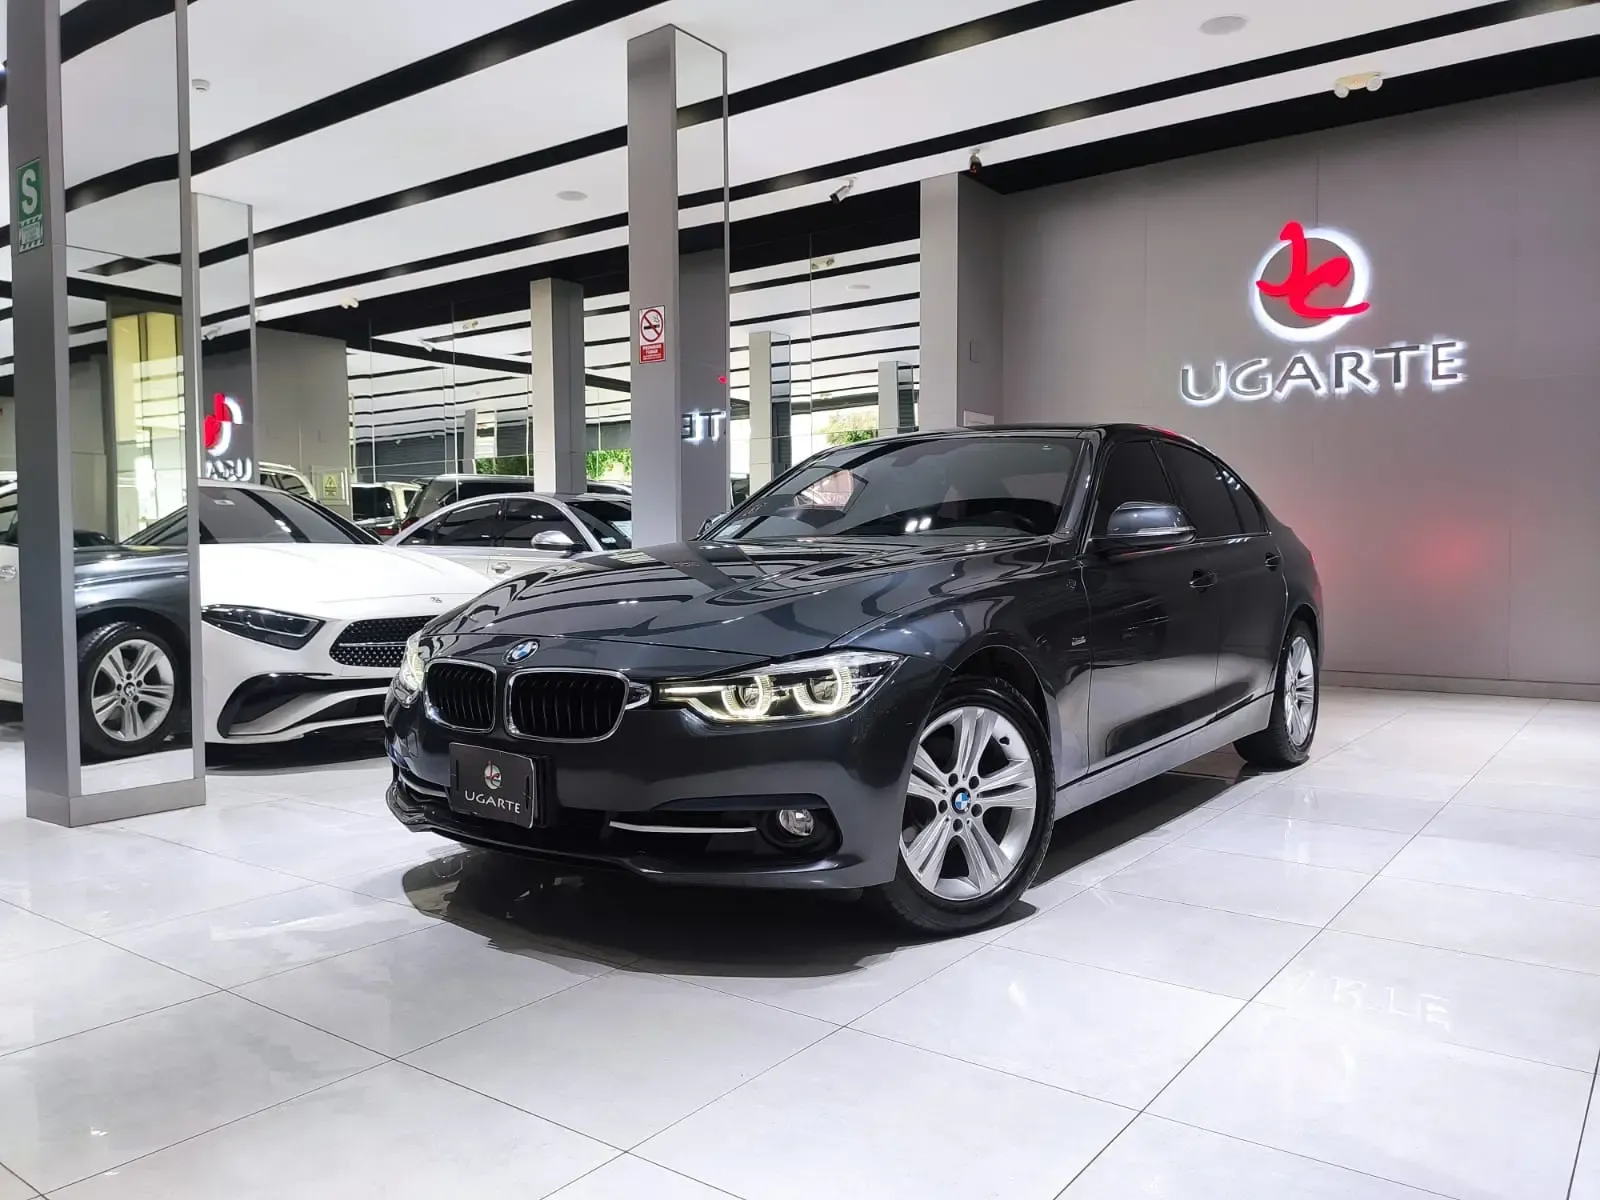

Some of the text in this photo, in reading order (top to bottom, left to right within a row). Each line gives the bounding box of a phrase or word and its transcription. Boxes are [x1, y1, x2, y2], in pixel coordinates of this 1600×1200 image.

[21, 168, 38, 215] S
[1180, 339, 1463, 405] UGARTE
[464, 790, 521, 814] UGARTE
